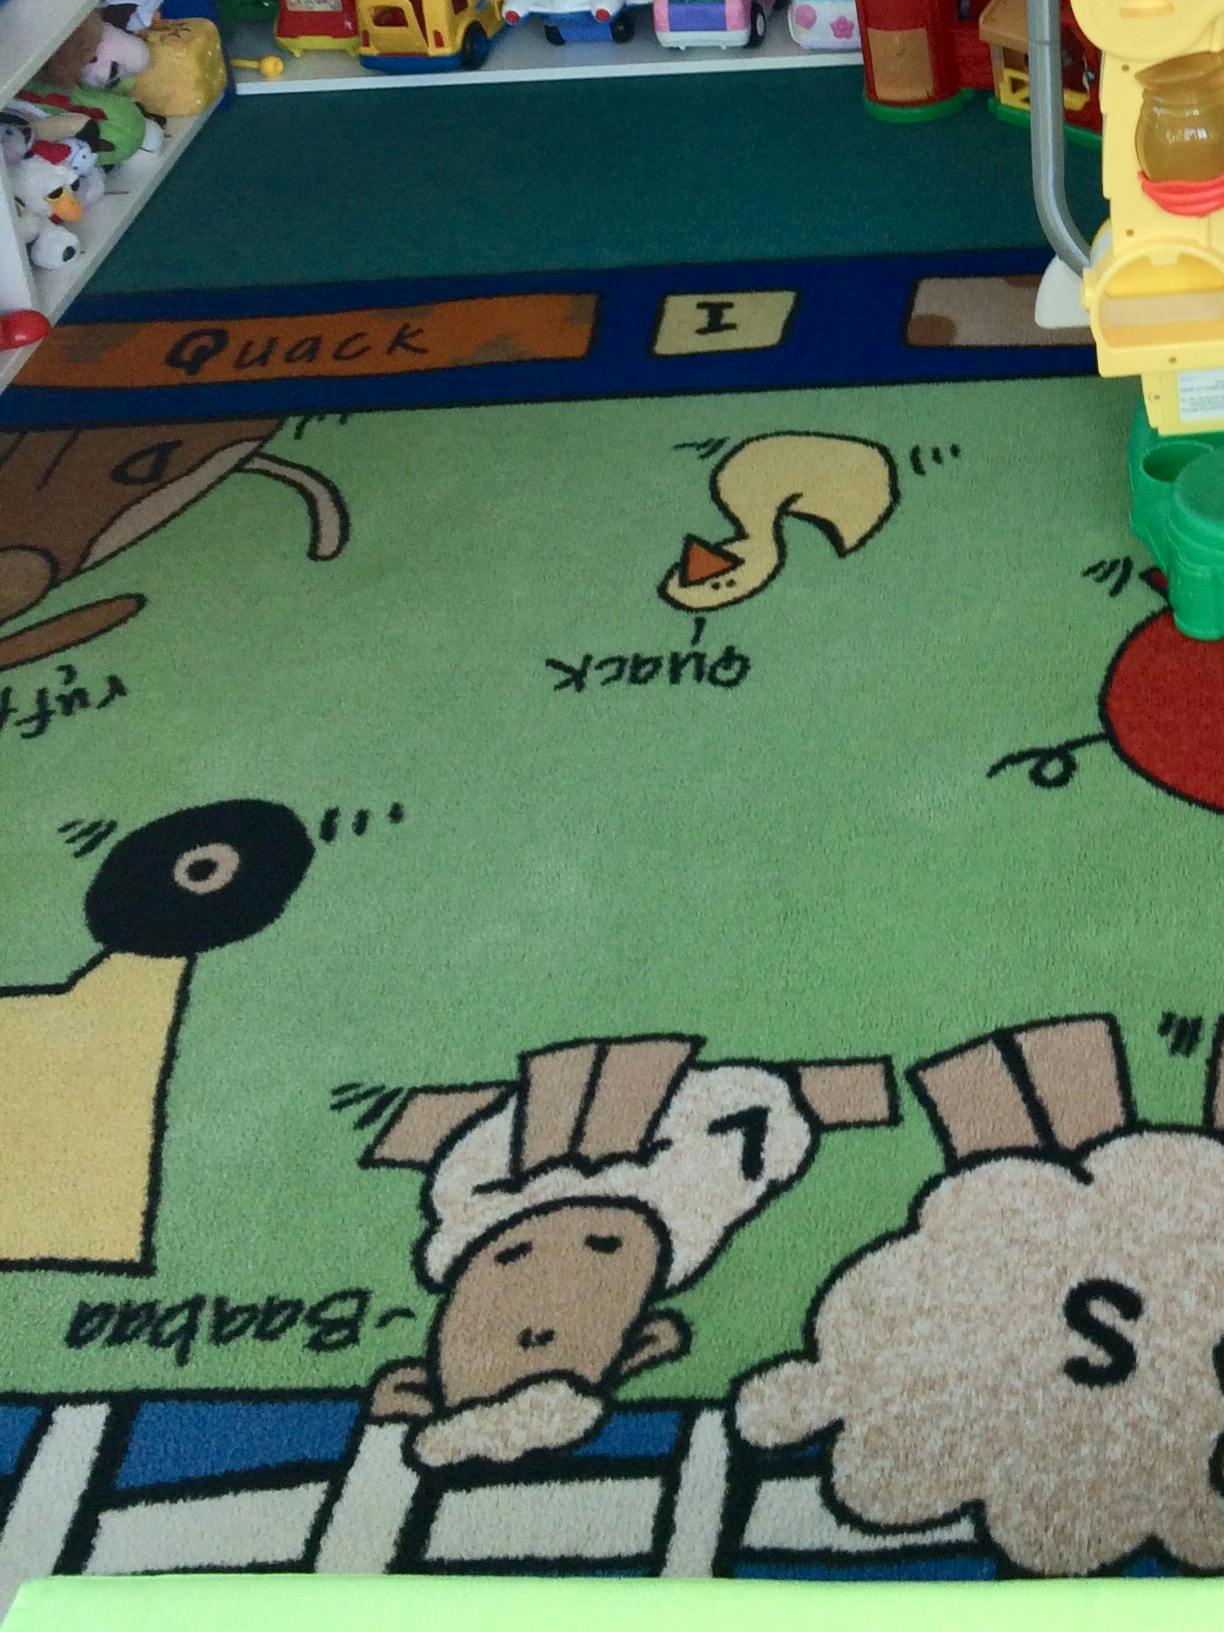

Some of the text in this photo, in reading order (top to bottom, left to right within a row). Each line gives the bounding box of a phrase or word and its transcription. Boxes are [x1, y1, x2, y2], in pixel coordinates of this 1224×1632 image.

[164, 322, 429, 375] Quack
[545, 645, 750, 692] Quack
[66, 1287, 373, 1368] Baabaa
[1062, 1278, 1144, 1391] S
